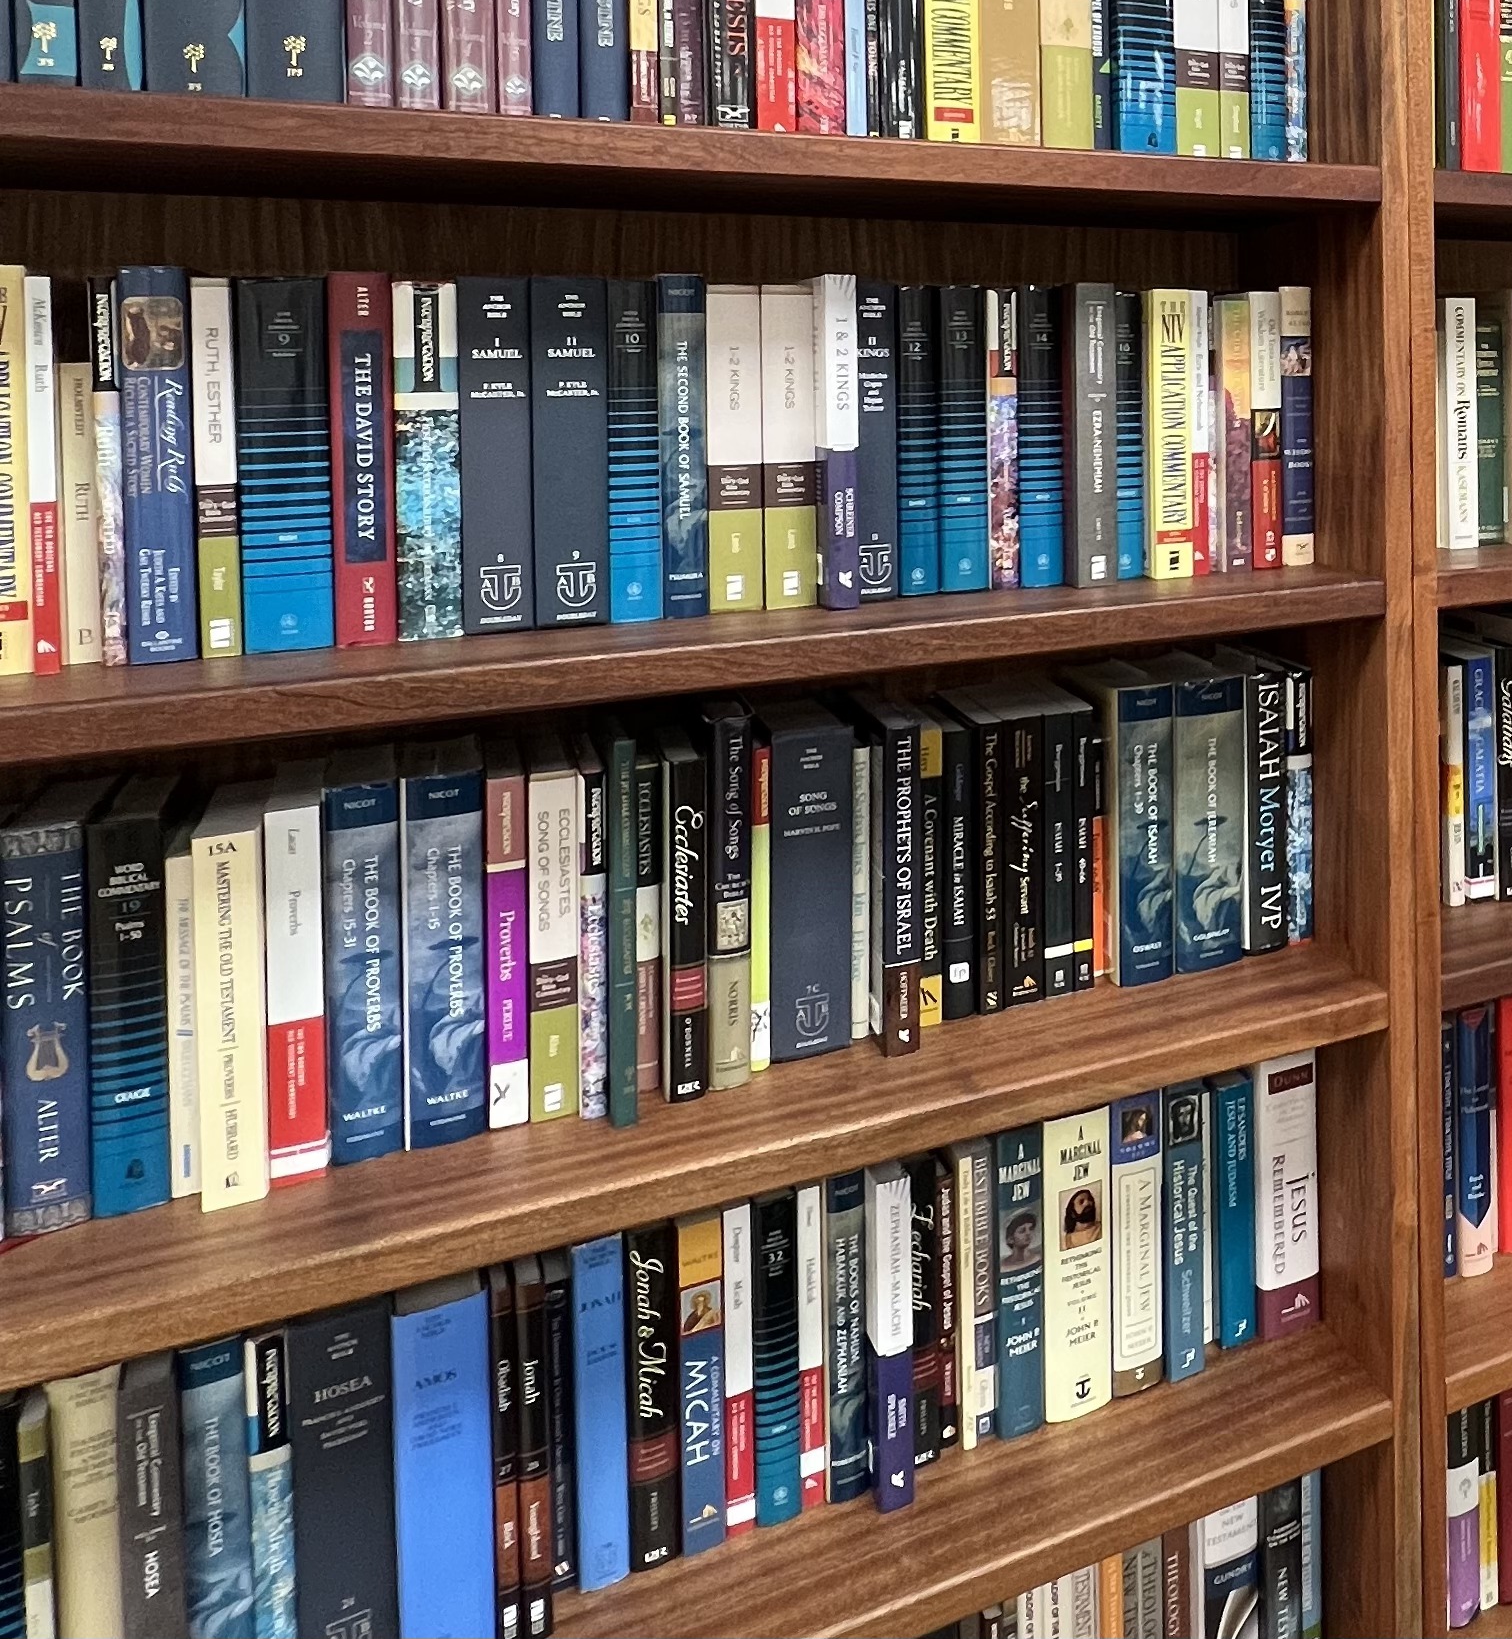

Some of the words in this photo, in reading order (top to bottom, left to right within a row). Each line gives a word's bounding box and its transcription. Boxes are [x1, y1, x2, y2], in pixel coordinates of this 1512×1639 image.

[931, 6, 973, 104] COMMENTARY
[356, 286, 369, 316] ALTER
[624, 333, 639, 343] 10
[1161, 314, 1185, 341] NIV
[205, 327, 220, 375] RUTH,
[472, 349, 522, 358] SAMUEL
[547, 348, 595, 357] SAMUEL
[676, 340, 688, 362] THE
[355, 354, 371, 396] THE
[677, 367, 689, 414] SECOND
[1160, 344, 1187, 428] APPLICATION
[161, 378, 186, 448] Reading
[208, 381, 221, 444] ESTHER
[355, 402, 372, 467] DAVID
[678, 416, 689, 452] BOOK
[159, 448, 187, 494] Ruth
[679, 454, 689, 468] OF
[1092, 410, 1104, 493] EZRA-NEHEMIAH
[74, 482, 89, 521] RUTH
[679, 470, 691, 519] SAMUEL
[1161, 435, 1188, 525] COMMENTARY
[358, 472, 374, 540] STORY
[728, 734, 743, 761] The
[897, 736, 912, 772] THE
[1259, 683, 1279, 781] ISAIAH
[343, 798, 376, 810] NICOT
[724, 763, 741, 801] Song
[538, 810, 550, 853] SONG
[637, 780, 651, 875] ECCLESIASTES
[723, 816, 739, 860] Songs
[897, 776, 912, 864] PROPHETS
[924, 809, 937, 870] Covenant
[953, 816, 964, 864] MIRACLE
[1256, 785, 1275, 873] Motyer
[207, 842, 236, 856] 15A
[365, 857, 379, 881] THE
[538, 856, 550, 876] OF
[674, 806, 703, 926] Ecclesiastes
[60, 873, 81, 921] THE
[216, 861, 232, 927] MASTERING
[897, 867, 912, 892] OF
[924, 875, 938, 912] with
[954, 879, 964, 926] ISAIAH
[121, 900, 140, 912] 19
[365, 884, 379, 931] BOOK
[538, 880, 550, 932] SONGS
[897, 893, 912, 954] ISRAEL
[1260, 884, 1282, 930] IVP
[3, 878, 35, 1008] PSALMS
[219, 928, 232, 950] THE
[366, 934, 379, 951] OF
[499, 911, 514, 982] Proverbs
[924, 917, 938, 962] Death
[61, 928, 84, 1000] BOOK
[219, 953, 233, 976] OLD
[219, 979, 236, 1043] TESTAMENT
[367, 956, 383, 1031] PROVERBS
[37, 1099, 59, 1162] ALTER
[342, 1104, 386, 1122] WALTKE
[1078, 1125, 1084, 1141] A
[999, 1157, 1041, 1184] MARGINAL
[1018, 1143, 1024, 1160] A
[1060, 1140, 1101, 1164] MARGINAL
[1072, 1165, 1089, 1182] JEW
[1012, 1182, 1029, 1202] JEW
[1139, 1180, 1148, 1193] A
[1173, 1160, 1184, 1221] Historical
[1286, 1172, 1315, 1245] JESUS
[1272, 1154, 1286, 1274] REMEMBERED
[767, 1251, 784, 1263] 32
[1139, 1197, 1152, 1281] MARGINAL
[1173, 1223, 1184, 1266] Jesus
[630, 1249, 663, 1321] Jonah
[1139, 1283, 1152, 1316] JEW
[1182, 1270, 1191, 1335] Schweitzer
[314, 1375, 373, 1403] HOSEA
[522, 1360, 540, 1405] Jonah
[639, 1341, 665, 1418] Micah
[686, 1360, 710, 1466] MICAH
[146, 1551, 160, 1600] HOSEA
[1167, 1551, 1180, 1637] THEOLOGY
[1214, 1562, 1252, 1585] GUNDRY
[1277, 1566, 1287, 1601] NEW
